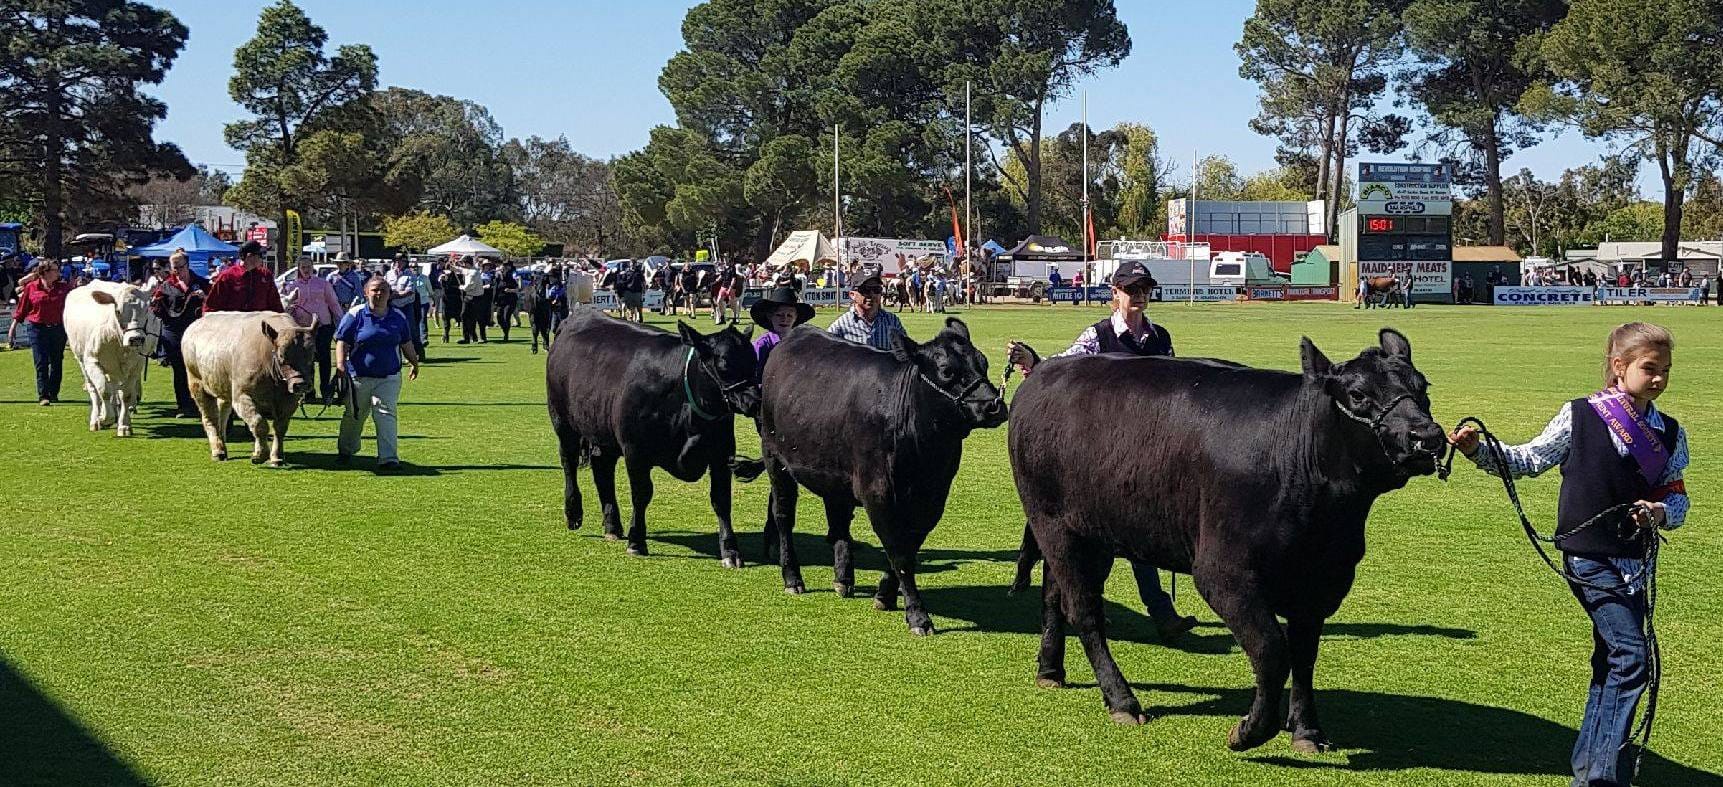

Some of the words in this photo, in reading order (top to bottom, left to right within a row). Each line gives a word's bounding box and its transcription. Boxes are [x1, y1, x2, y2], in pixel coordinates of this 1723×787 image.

[1416, 262, 1447, 273] MEATS
[1414, 275, 1447, 283] HOTEL
[1606, 288, 1647, 297] TILER
[1497, 293, 1592, 302] CONCRETE
[1609, 418, 1633, 444] AWARD
